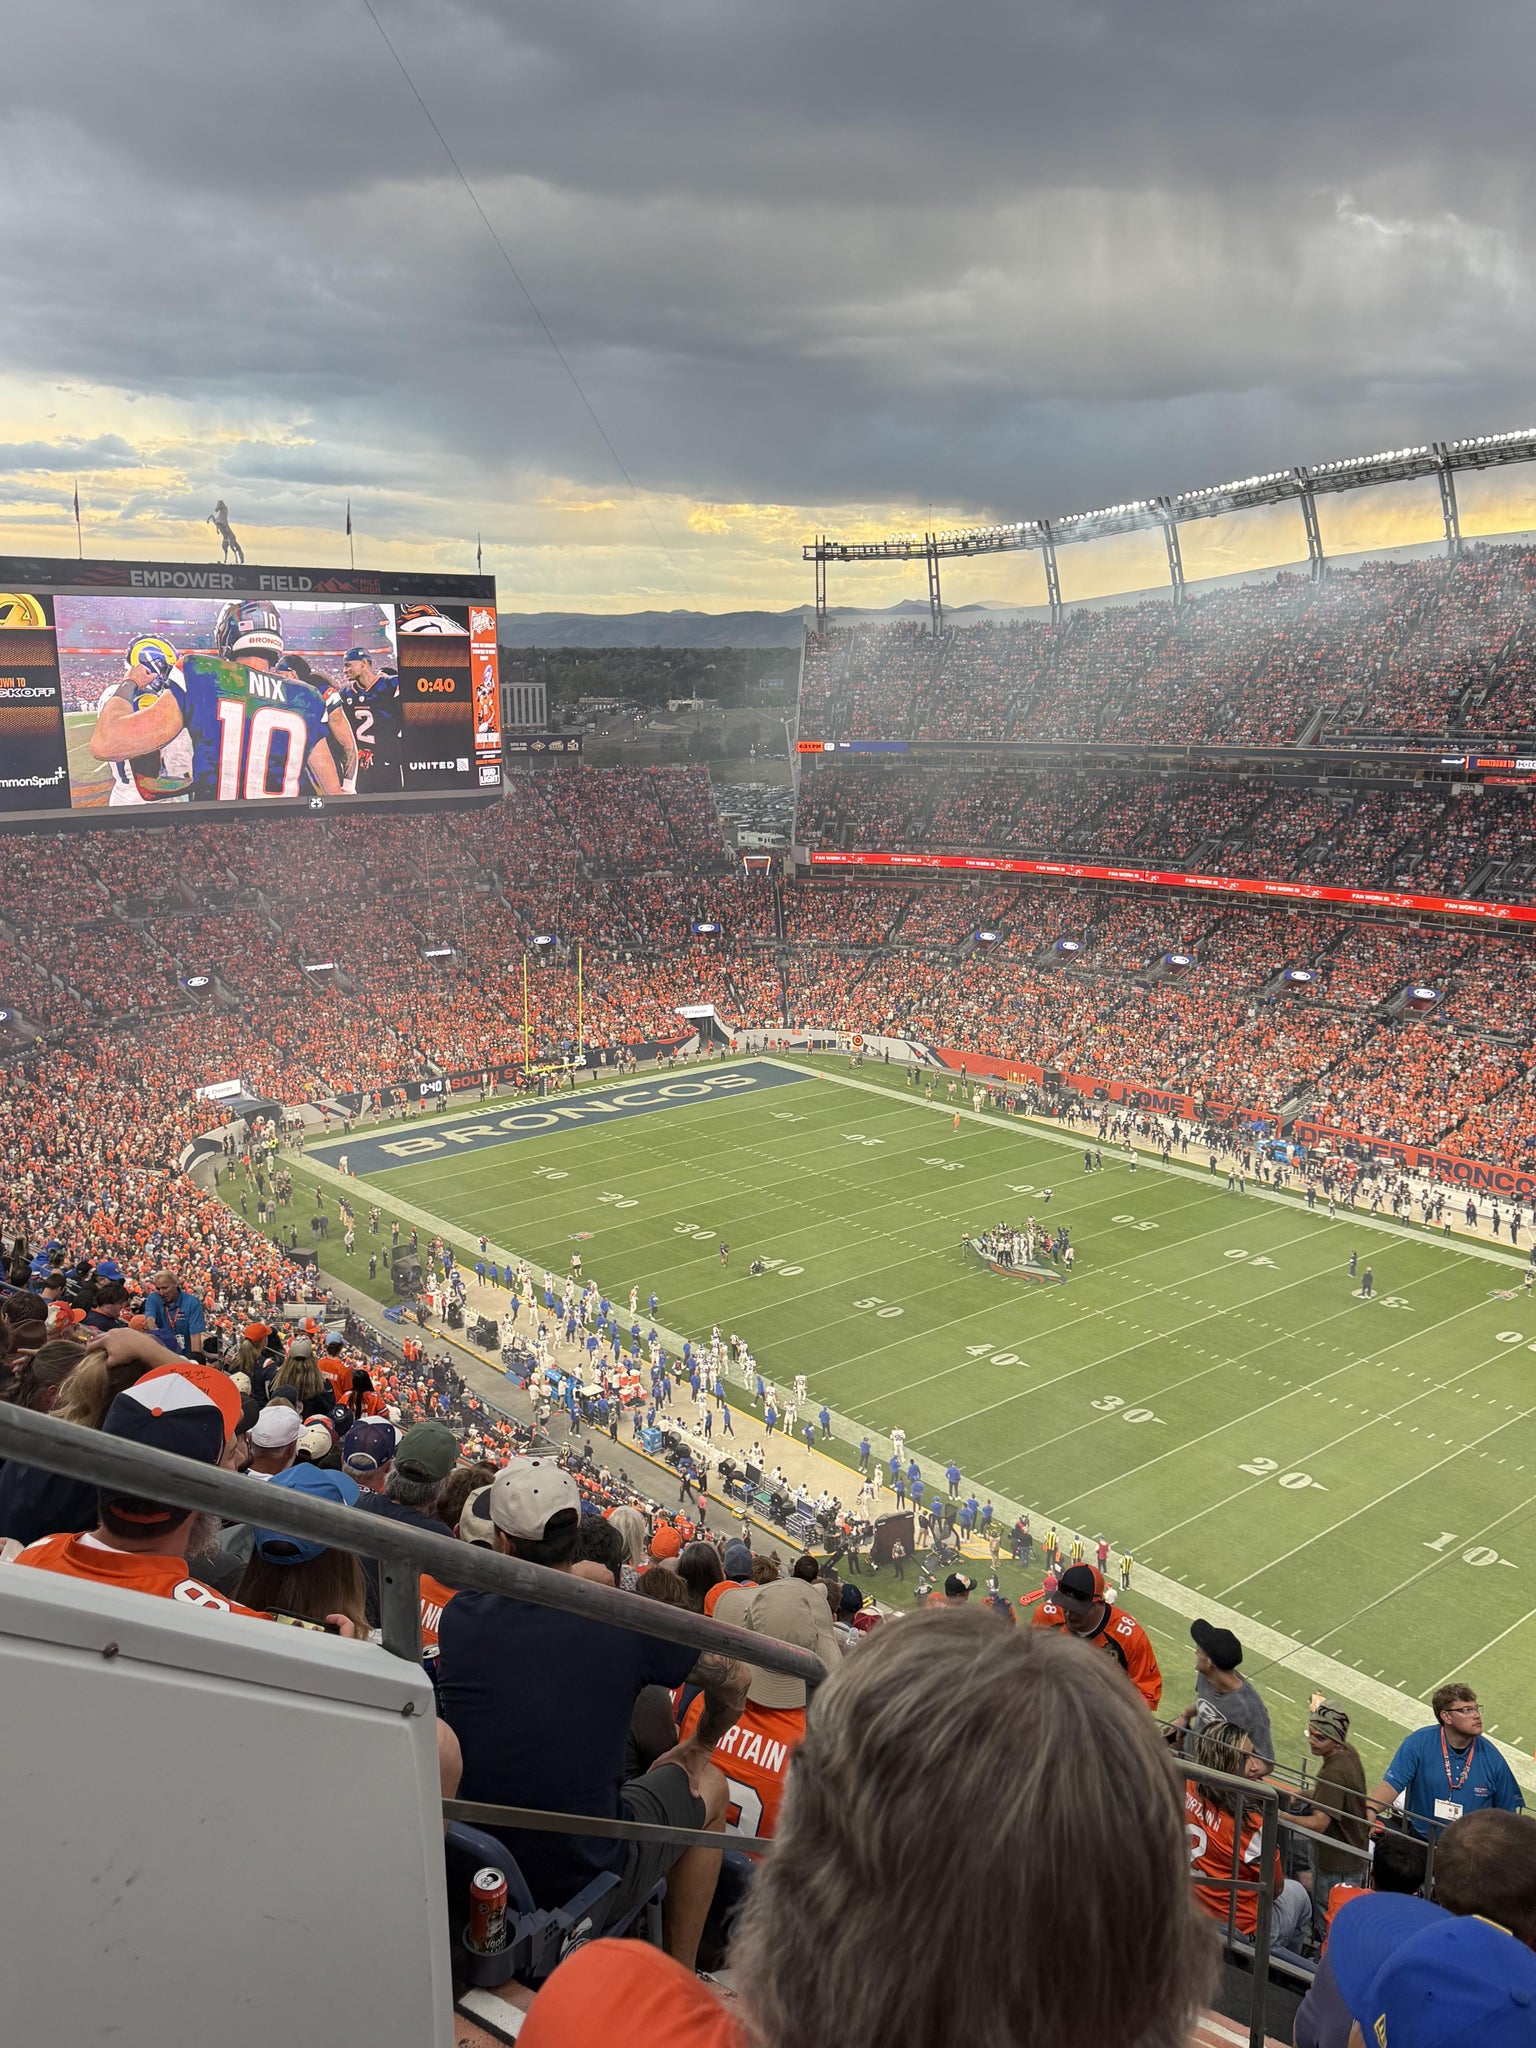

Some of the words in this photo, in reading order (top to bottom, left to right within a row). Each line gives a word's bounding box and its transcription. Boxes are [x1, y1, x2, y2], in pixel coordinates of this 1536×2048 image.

[130, 570, 234, 589] EMPOWER
[259, 574, 313, 592] FIELD
[359, 578, 380, 587] MILE
[359, 586, 382, 594] HIGH
[262, 611, 278, 631] 10
[16, 677, 26, 688] TO
[249, 672, 286, 702] NIX
[416, 677, 456, 693] 0:40
[354, 709, 376, 745] 2
[217, 698, 308, 801] 10
[409, 761, 455, 771] UNITED
[482, 767, 496, 775] BUD
[480, 774, 499, 784] LIGHT
[310, 798, 323, 808] 25
[1444, 902, 1458, 910] FAN
[1458, 903, 1477, 911] WORK
[420, 1079, 443, 1096] 0:40
[469, 1096, 546, 1116] INSPIRE
[1122, 1087, 1185, 1115] HOME
[377, 1073, 759, 1158] BRONCOS
[776, 1111, 808, 1123] 10
[847, 1133, 886, 1146] 20
[924, 1157, 965, 1171] 30
[531, 1166, 569, 1180] 10
[597, 1192, 639, 1208] 20
[673, 1222, 717, 1240] 30
[1111, 1214, 1159, 1231] 50
[1223, 1249, 1271, 1267] 40
[852, 1296, 904, 1318] 50
[964, 1344, 1020, 1367] 40
[1090, 1395, 1154, 1423] 30
[1238, 1457, 1313, 1490] 20
[1422, 1532, 1498, 1566] 10
[1116, 1615, 1136, 1637] 58
